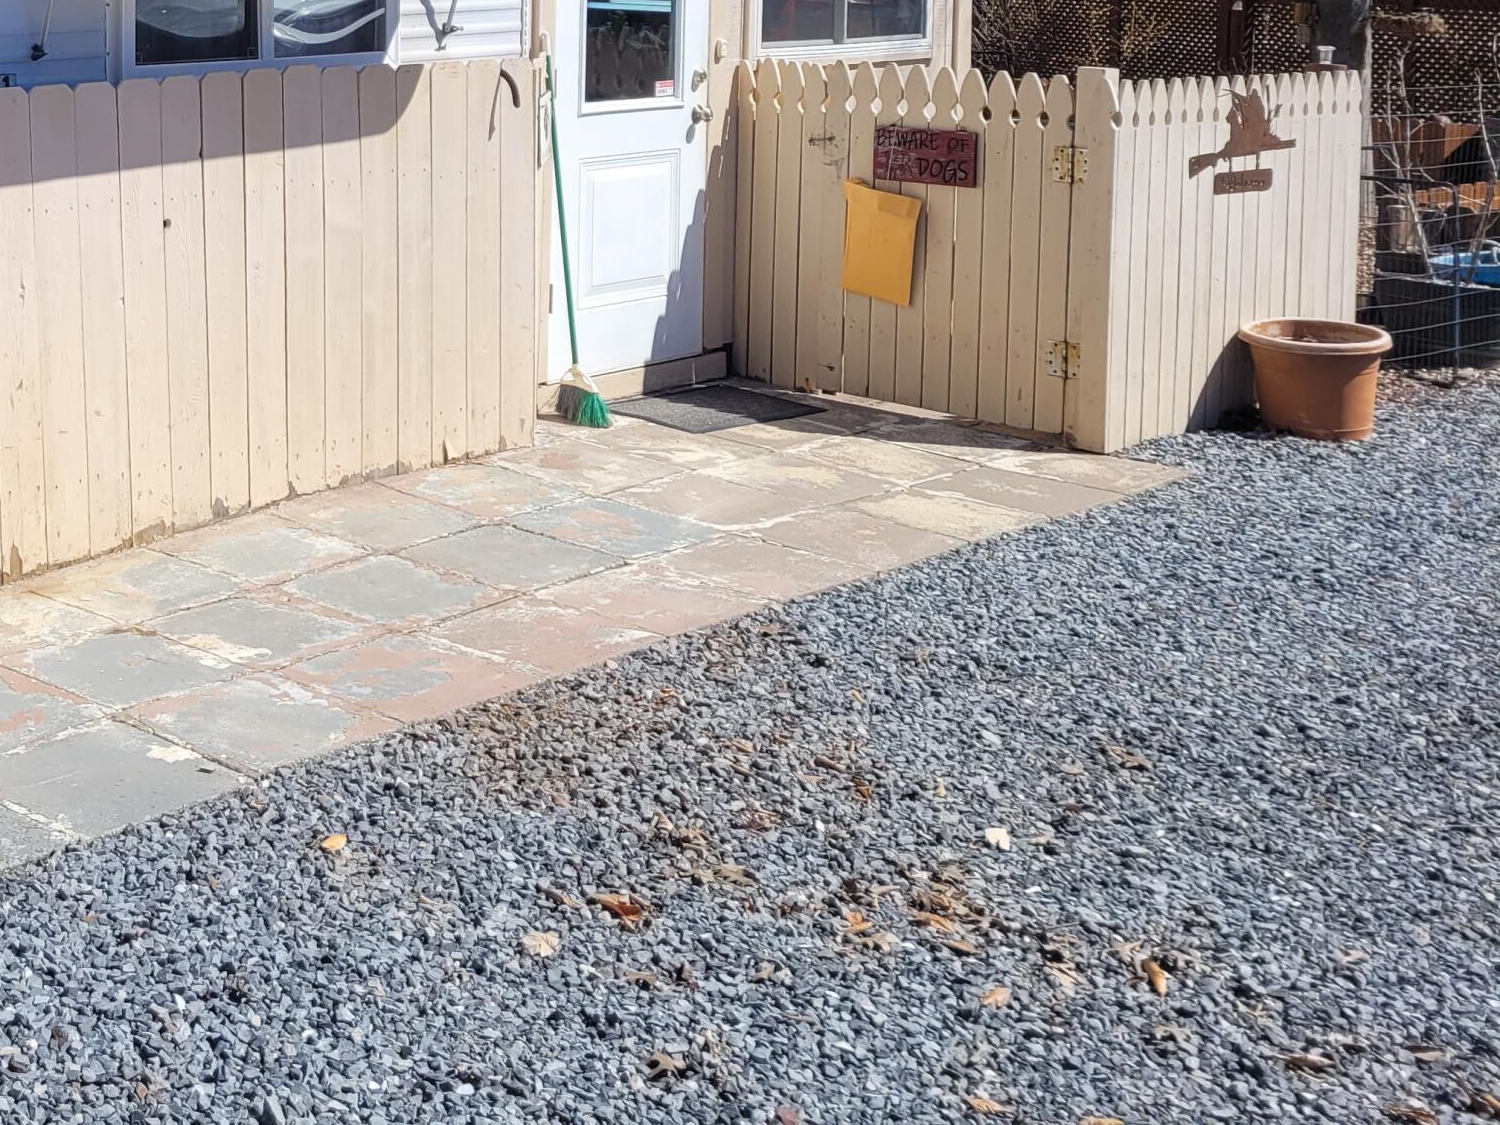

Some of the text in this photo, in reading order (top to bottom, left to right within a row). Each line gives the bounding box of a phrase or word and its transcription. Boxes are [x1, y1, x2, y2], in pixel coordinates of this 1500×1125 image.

[875, 127, 970, 153] BEWARE OF
[915, 157, 969, 184] DOGS
